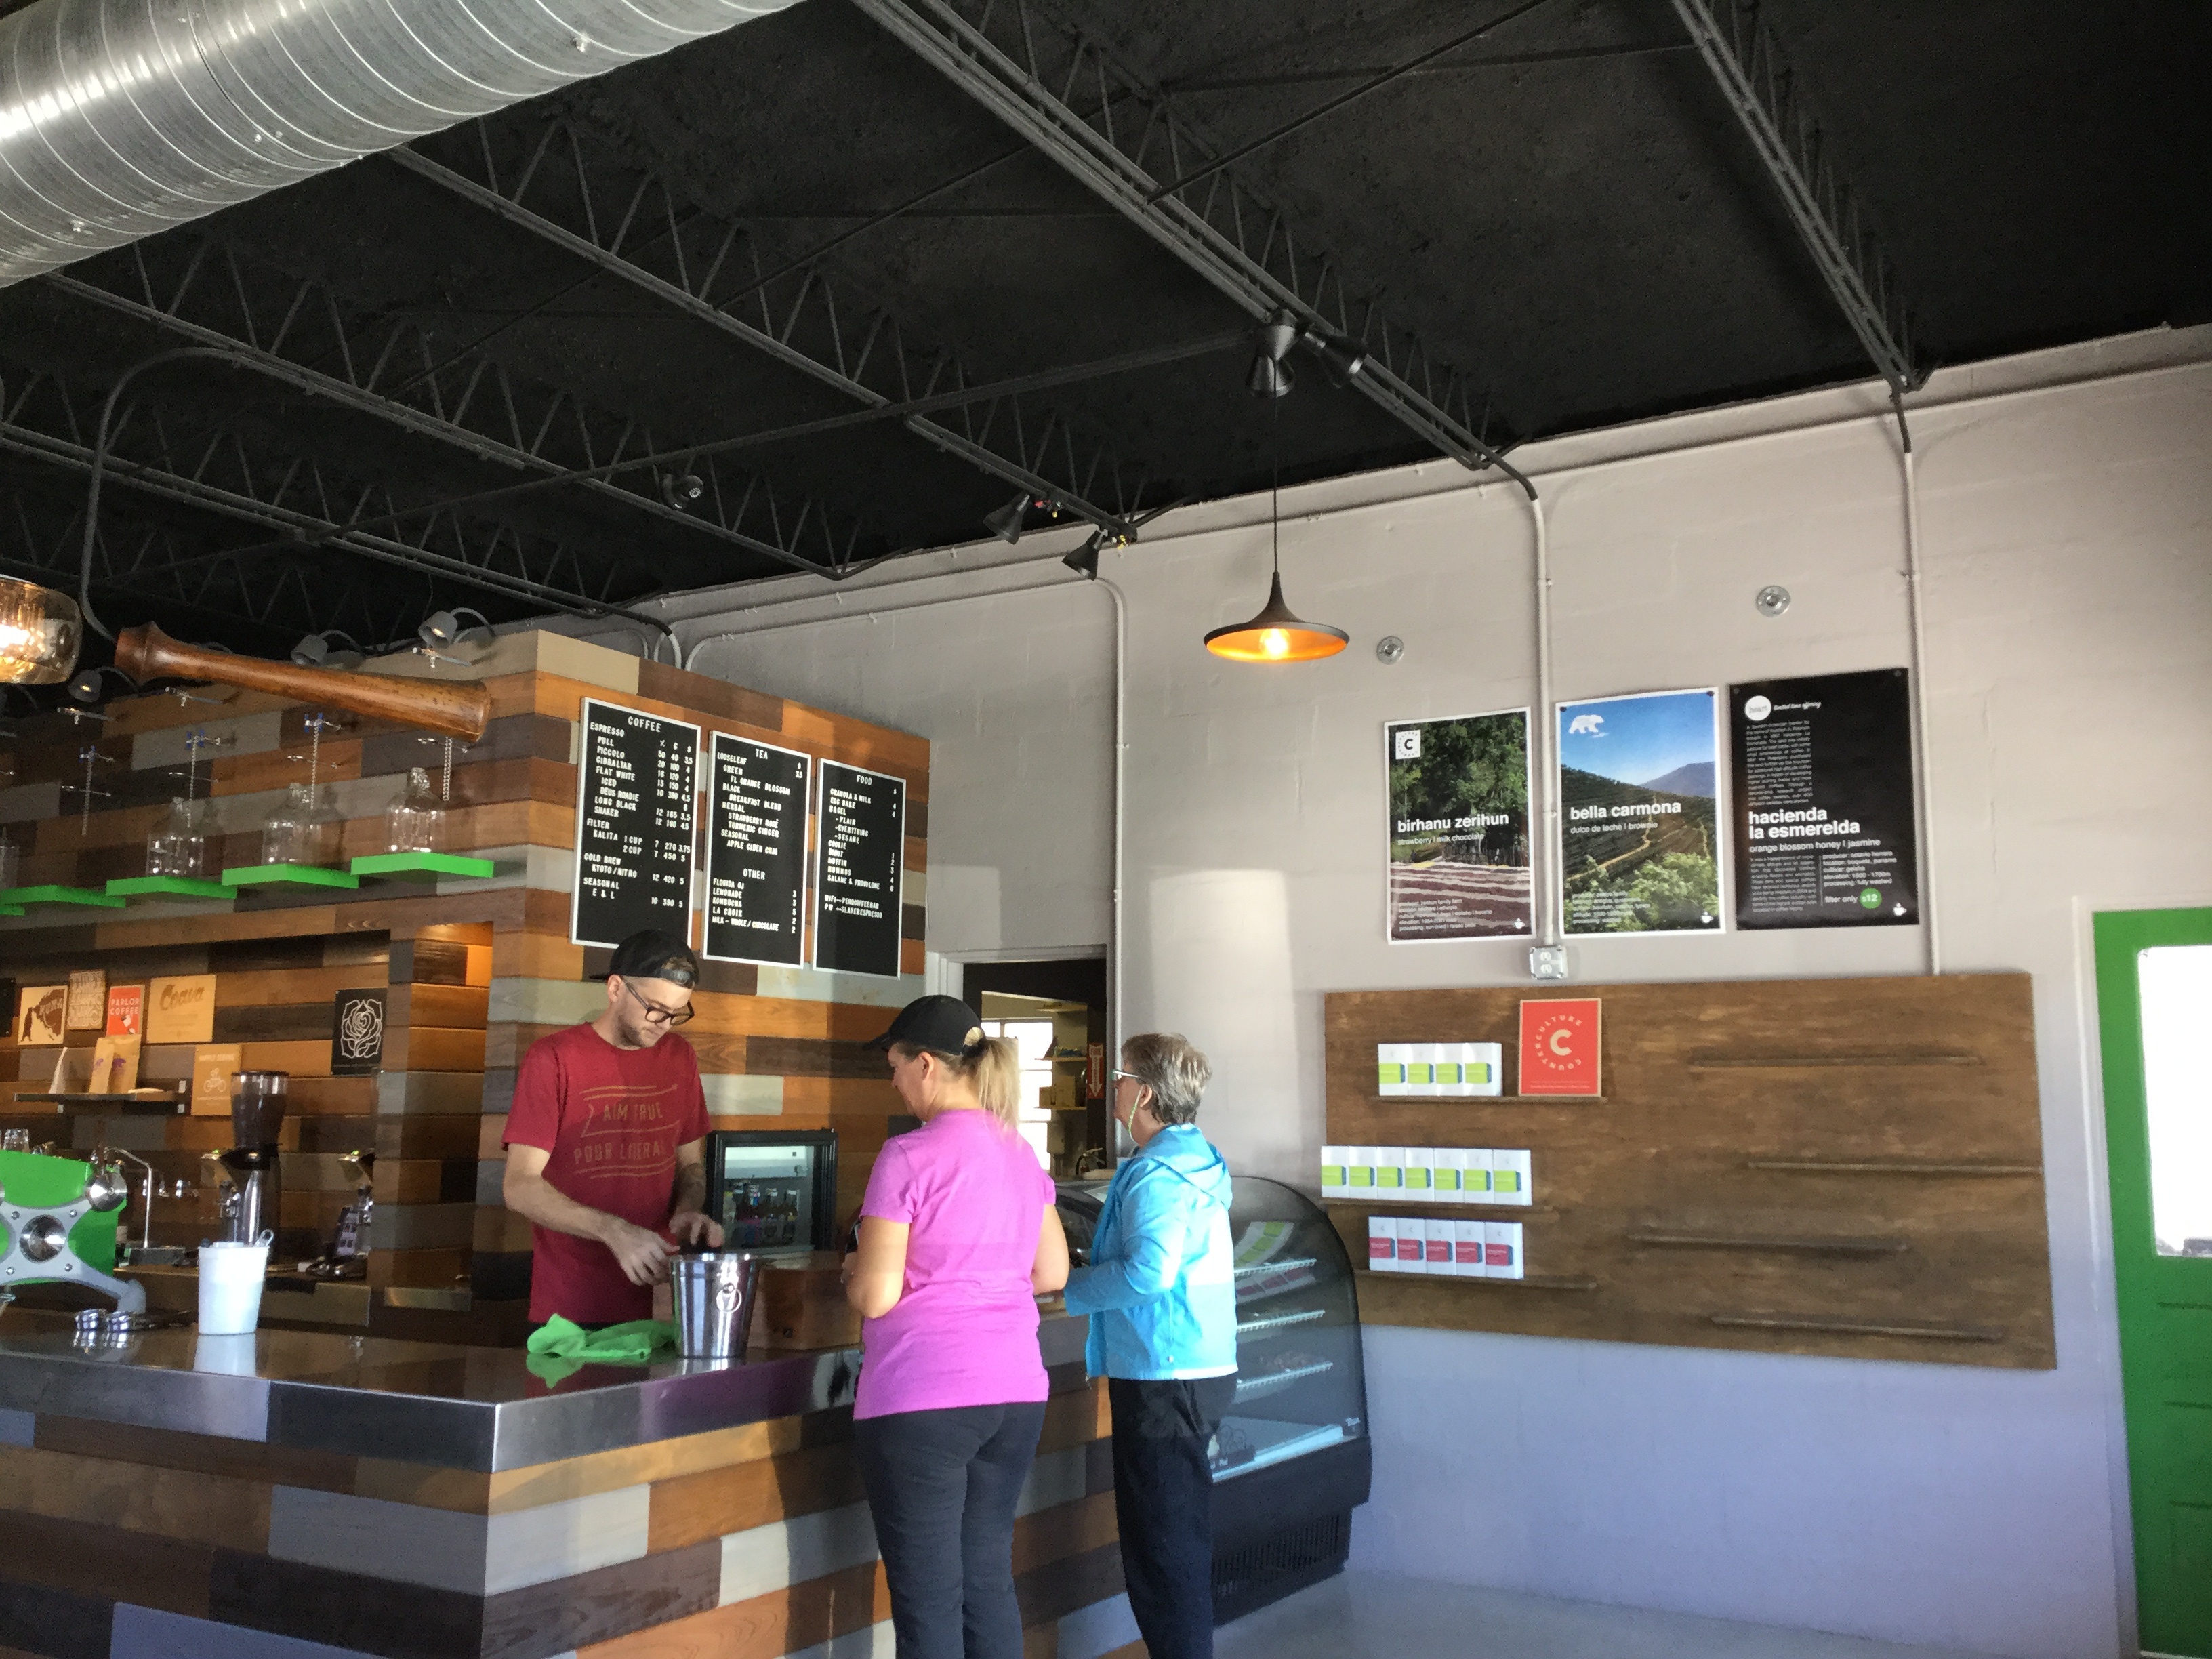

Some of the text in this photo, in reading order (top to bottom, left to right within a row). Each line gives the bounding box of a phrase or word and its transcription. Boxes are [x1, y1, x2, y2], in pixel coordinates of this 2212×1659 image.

[590, 722, 624, 737] ESPRESSO
[628, 716, 661, 732] COFFEE
[598, 736, 614, 747] PULL
[658, 750, 665, 758] 50
[671, 754, 679, 762] 40
[1404, 738, 1413, 750] C
[597, 745, 625, 759] PICCOLO
[670, 763, 680, 771] 100
[717, 752, 747, 765] LOOSELEAF
[756, 748, 768, 760] TEA
[596, 756, 632, 771] GIBRALTAR
[670, 772, 679, 781] 120
[723, 764, 743, 775] GREEN
[596, 766, 613, 776] FLAT
[616, 770, 635, 781] WHITE
[657, 779, 664, 787] 13
[669, 781, 679, 790] 150
[601, 777, 617, 787] ICED
[857, 775, 872, 785] FOOD
[722, 783, 740, 794] BLACK
[731, 775, 790, 795] FL ORANGE BLOSSOM
[600, 787, 616, 797] DEUS
[617, 790, 639, 802] ROADIE
[830, 788, 852, 799] GRANOLA
[859, 795, 871, 804] MILK
[722, 802, 745, 813] HERBAL
[729, 794, 782, 811] BREAKFAST BLEND
[830, 796, 840, 805] EGG
[842, 800, 855, 808] BAKE
[594, 796, 613, 806] LONG
[616, 800, 636, 811] BLACK
[656, 808, 663, 816] 12
[680, 813, 691, 821] 3.5
[829, 805, 846, 815] BAGEL
[1570, 802, 1681, 820] bella carmona
[594, 806, 619, 817] SHAKER
[655, 817, 662, 825] 12
[728, 812, 763, 825] STRAWBERRY
[1748, 807, 1827, 825] hacienda
[587, 818, 609, 829] FILTER
[1397, 814, 1509, 832] birhanu zerihun
[1570, 826, 1590, 834] dulce
[1602, 823, 1622, 832] leche
[1628, 822, 1658, 830] brownie
[1749, 819, 1860, 839] la esmerelda
[721, 829, 749, 841] SEASONAL
[729, 821, 779, 838] TURMERIC GINGER
[593, 830, 618, 840] KALITA
[629, 836, 642, 845] CUP
[655, 840, 659, 848] 7
[665, 842, 676, 851] 270
[678, 844, 691, 853] 3.75
[726, 840, 778, 855] APPLE CIDER CHAI
[828, 840, 846, 849] COOKIE
[1397, 837, 1432, 846] strawberry
[1749, 838, 1881, 853] orange blossom honey jasmine
[584, 853, 621, 865] COLD BREW
[628, 846, 642, 855] CUP
[663, 852, 676, 861] 450
[827, 857, 847, 867] MUFFIN
[743, 868, 765, 880] OTHER
[827, 865, 851, 876] HUMMUS
[583, 877, 619, 889] SEASONAL
[663, 876, 675, 884] 420
[713, 878, 735, 888] FLORIDA
[737, 882, 744, 890] OJ
[855, 879, 880, 890] PROVOLONE
[611, 891, 615, 899] L
[713, 888, 742, 899] LEMONADE
[1842, 895, 1858, 903] only
[712, 897, 742, 907] KOMBUCHA
[724, 908, 742, 917] CROIX
[712, 916, 724, 924] MILK
[110, 998, 140, 1006] PARLOR
[110, 1007, 139, 1015] COFFEE
[1550, 1029, 1572, 1056] C
[602, 1102, 663, 1121] AIM TRUE
[573, 1142, 614, 1164] POUR
